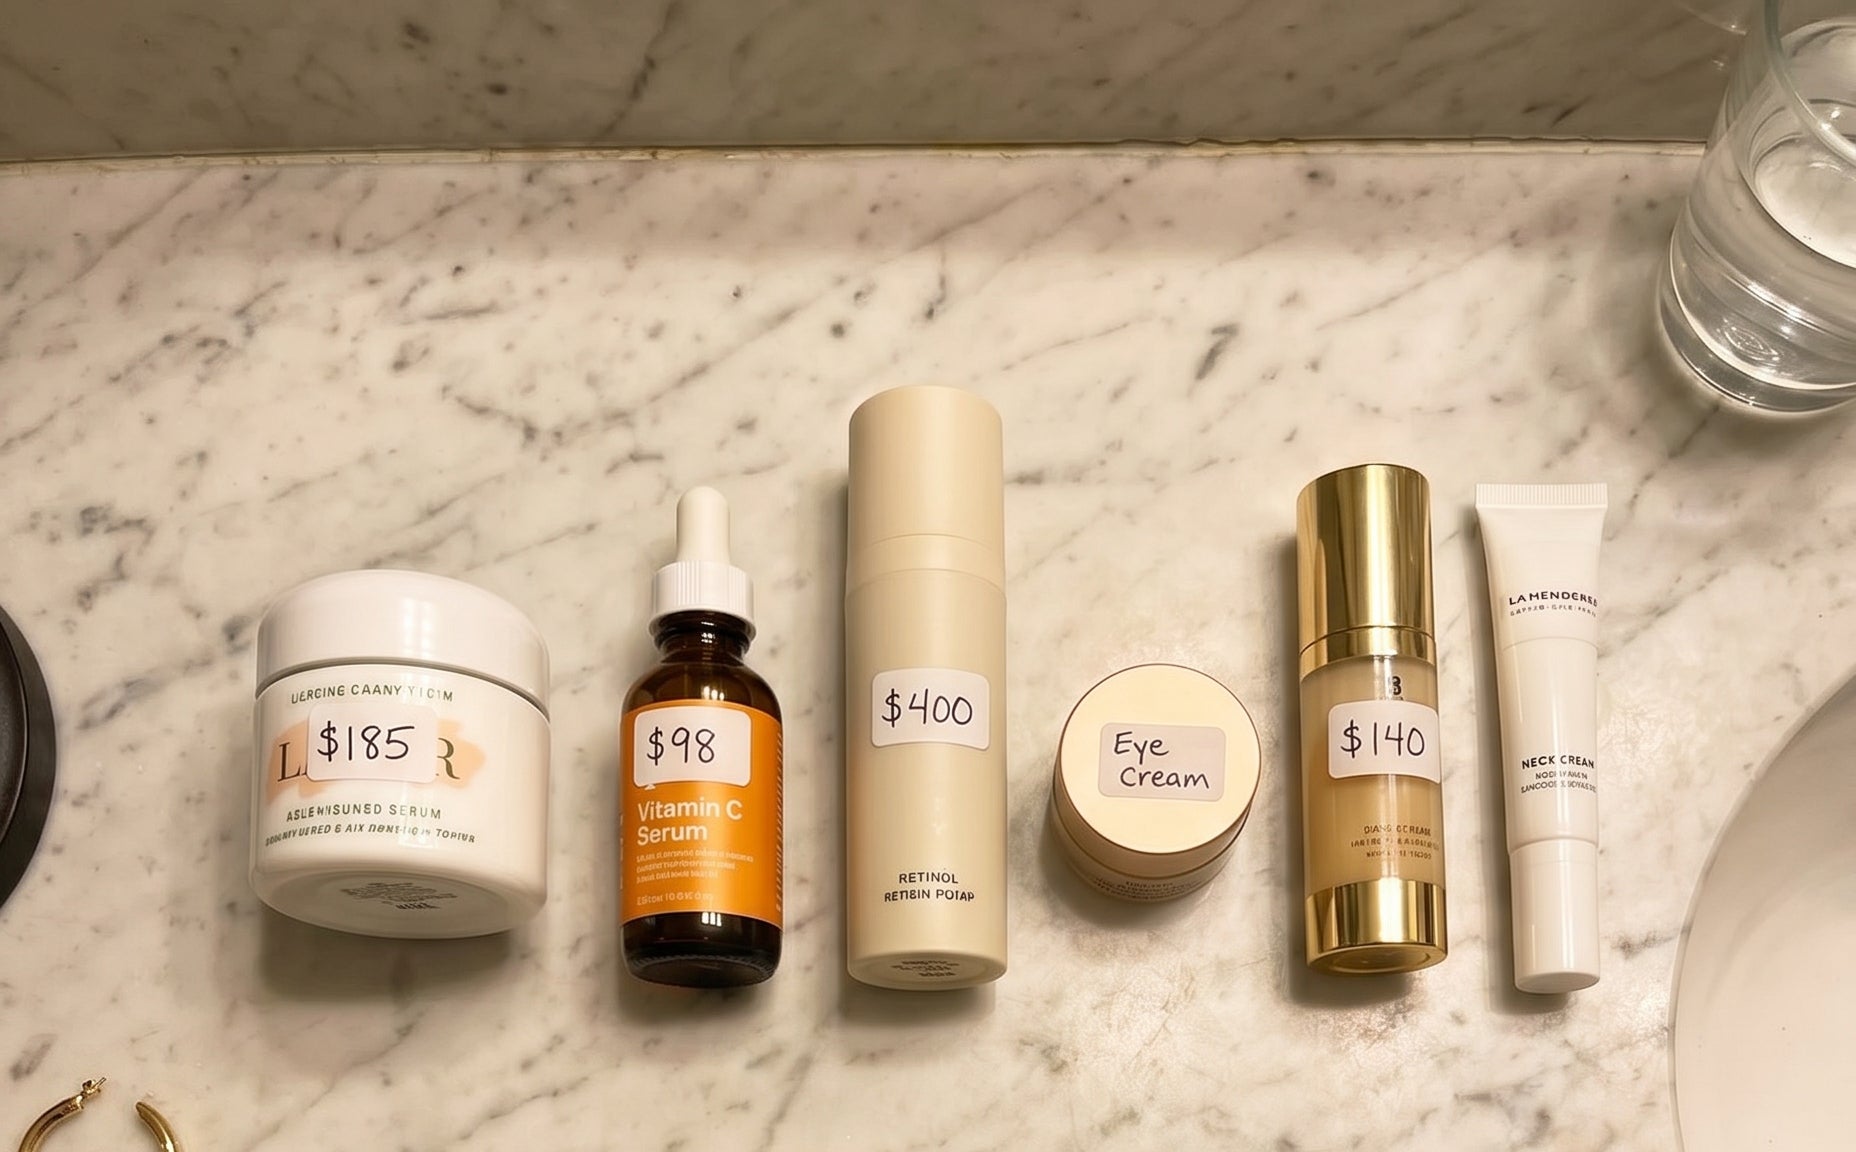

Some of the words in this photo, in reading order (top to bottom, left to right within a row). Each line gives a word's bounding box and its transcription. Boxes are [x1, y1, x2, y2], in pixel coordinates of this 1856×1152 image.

[882, 688, 973, 728] $400
[317, 721, 415, 762] $185
[646, 726, 716, 766] $98
[1113, 731, 1169, 765] Eye
[1340, 719, 1425, 758] $140
[1521, 755, 1556, 770] NECK
[1120, 766, 1210, 789] Cream
[389, 804, 441, 819] SERUM
[637, 797, 720, 822] Vitamin
[725, 799, 743, 820] C
[637, 825, 708, 846] Serum
[899, 871, 959, 884] RETINOL
